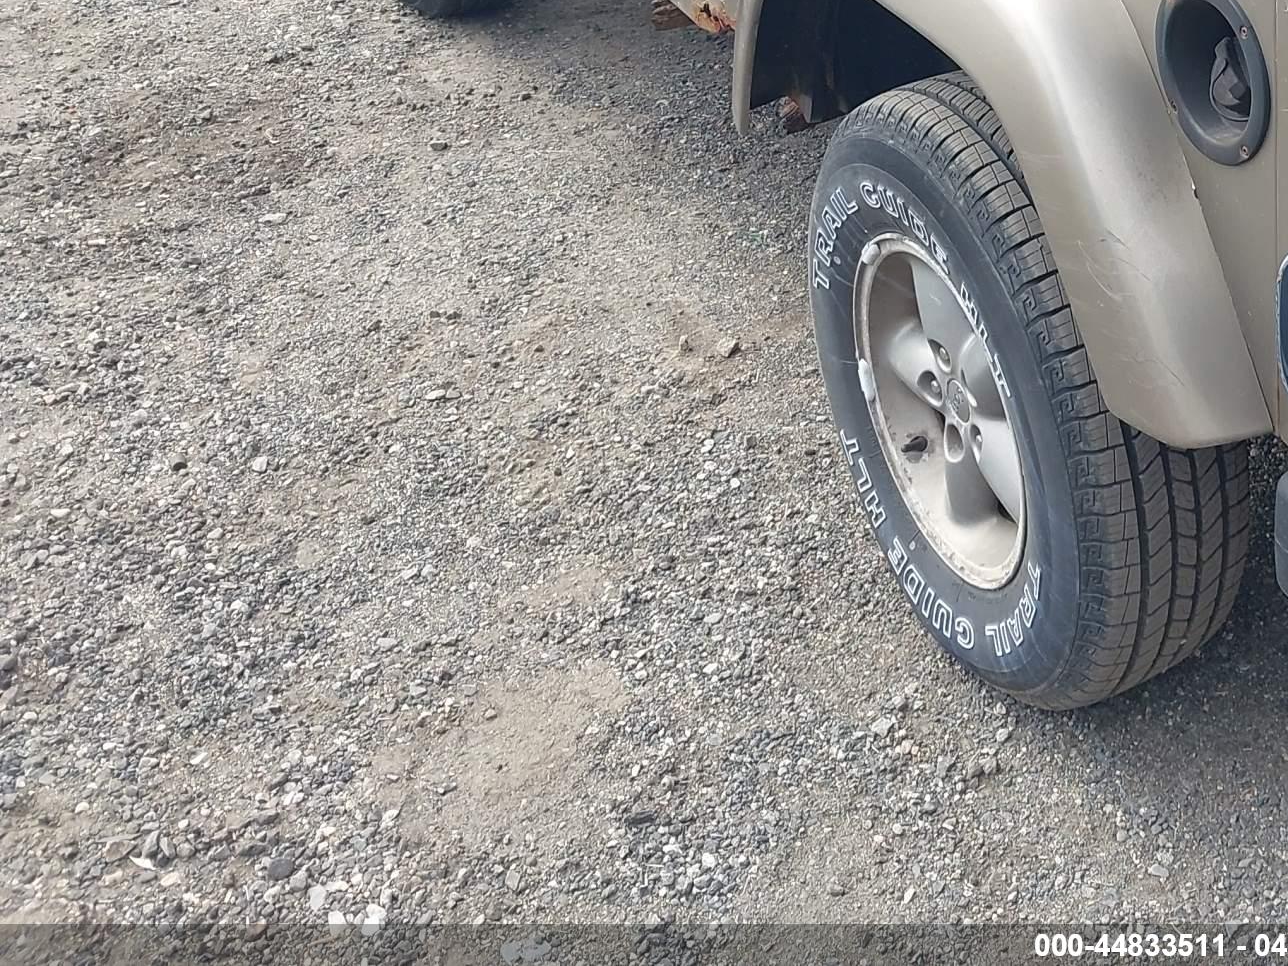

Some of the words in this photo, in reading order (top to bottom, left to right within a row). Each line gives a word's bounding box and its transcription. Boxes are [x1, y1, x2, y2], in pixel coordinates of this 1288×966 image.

[812, 186, 859, 290] TRAIL
[860, 181, 949, 275] GUIDE
[839, 428, 887, 529] HLT
[887, 535, 976, 650] GUIDE
[985, 559, 1042, 657] TRAIL
